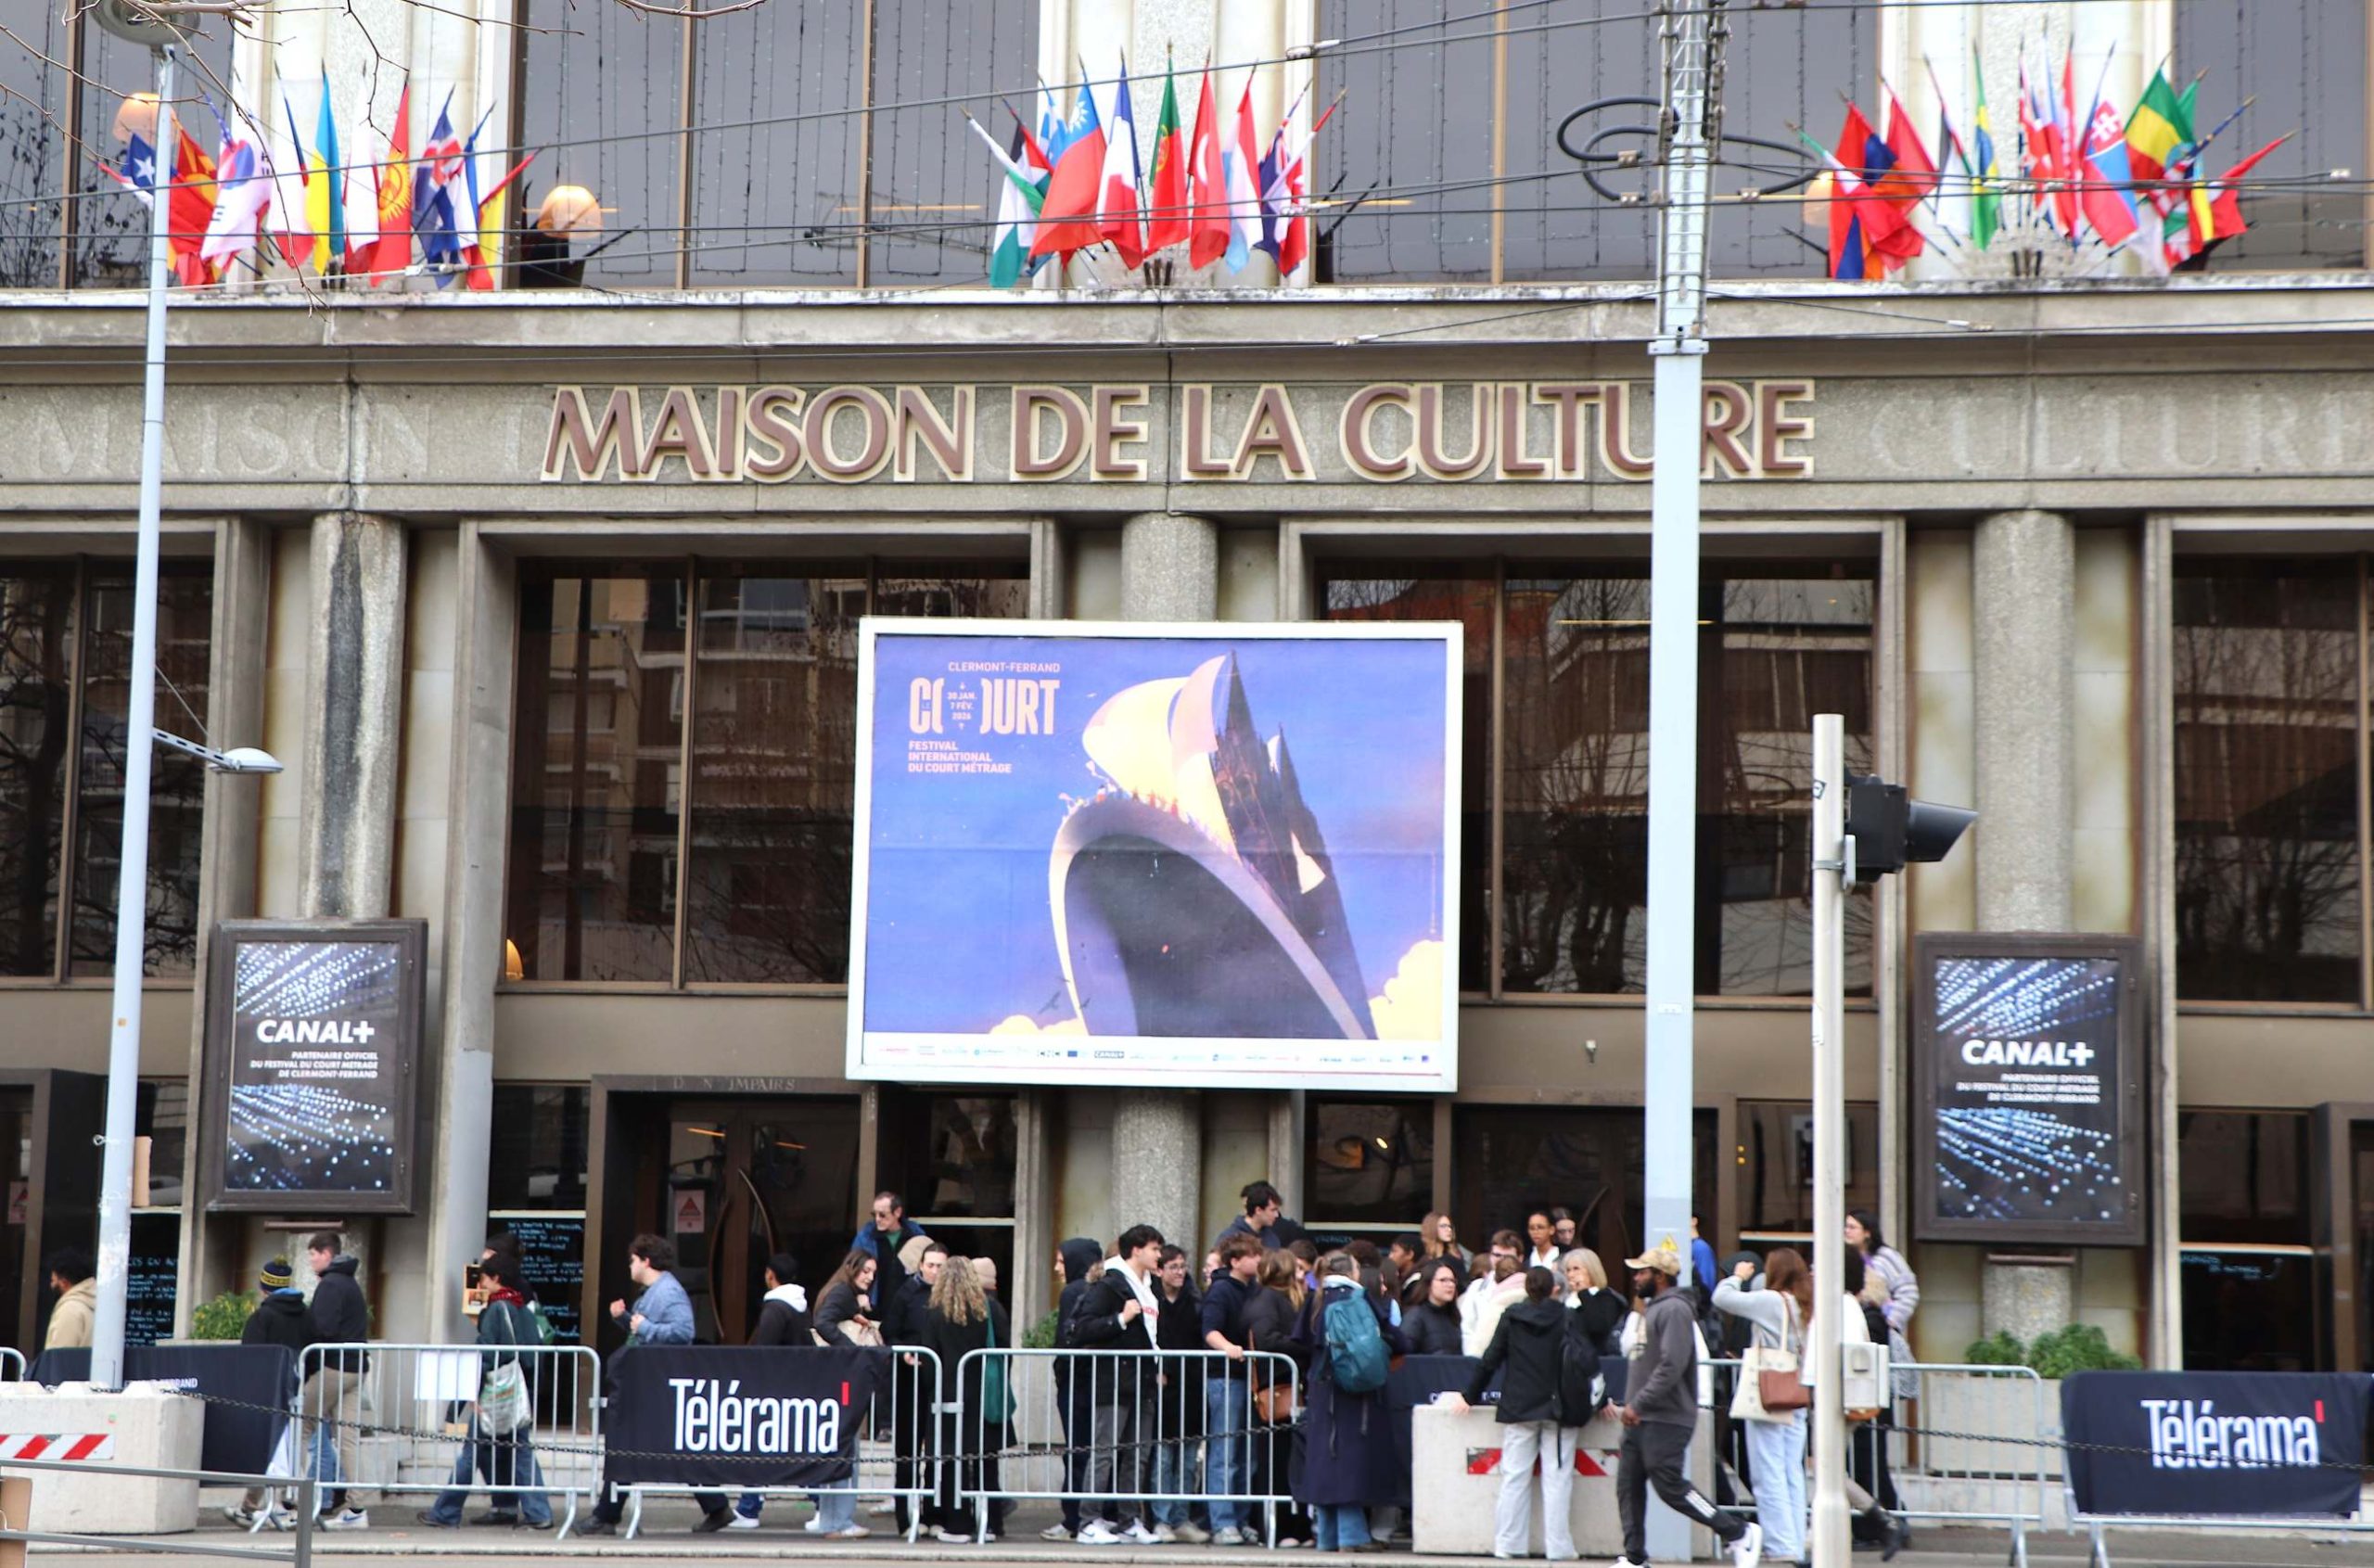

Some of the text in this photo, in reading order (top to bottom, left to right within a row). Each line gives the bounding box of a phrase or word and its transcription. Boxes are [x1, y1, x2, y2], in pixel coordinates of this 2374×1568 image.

[541, 385, 973, 482] MAISON
[1010, 384, 1149, 481] DE
[1181, 383, 1317, 481] LA
[1339, 380, 1815, 481] CULTURE
[948, 662, 1061, 673] CLERMONT-FERRAND
[909, 741, 959, 751] FESTIVAL
[909, 752, 993, 762] INTERNATIONAL
[909, 763, 924, 772] DU
[925, 763, 960, 772] COURT
[256, 1019, 375, 1044] CANAL+
[291, 1051, 378, 1061] PARTENAIRE OFFICIEL
[1961, 1039, 2095, 1066] CANAL+
[250, 1060, 263, 1069] DU
[264, 1060, 299, 1069] FESTIVAL
[300, 1061, 313, 1069] DU
[290, 1069, 378, 1079] CLERMONT-FERRAND
[669, 1378, 840, 1453] Télérama
[2141, 1400, 2320, 1469] Télérama
